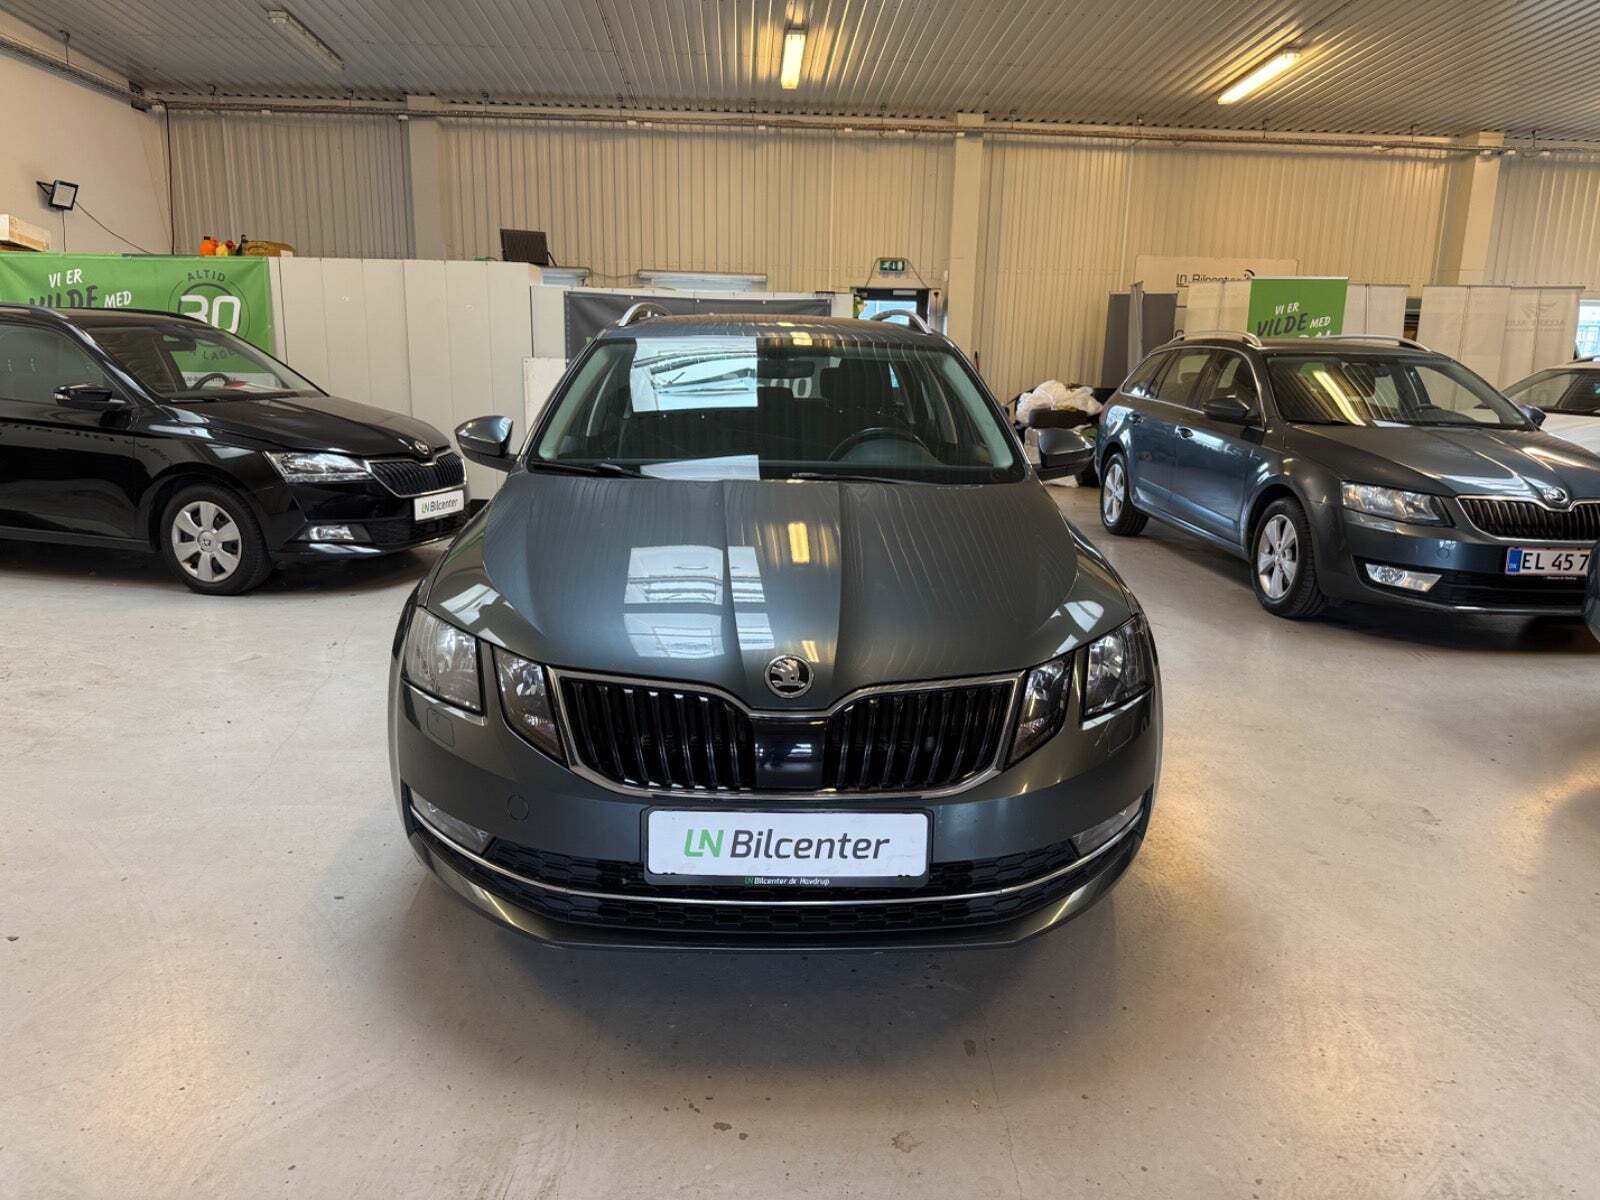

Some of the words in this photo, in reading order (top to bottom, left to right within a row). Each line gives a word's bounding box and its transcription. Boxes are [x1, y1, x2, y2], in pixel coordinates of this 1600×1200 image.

[48, 272, 61, 288] VI
[66, 268, 83, 284] ER
[187, 270, 226, 281] ALTID
[103, 291, 132, 308] MED
[1275, 305, 1284, 315] VI
[1287, 302, 1300, 313] ER
[180, 295, 241, 334] 30
[1257, 313, 1308, 336] VILDE
[1310, 316, 1331, 328] MED
[430, 499, 458, 512] Bilcenter
[1521, 552, 1545, 570] EL
[1552, 553, 1574, 571] 45
[683, 828, 725, 858] LN
[729, 828, 890, 860] Bilcenter
